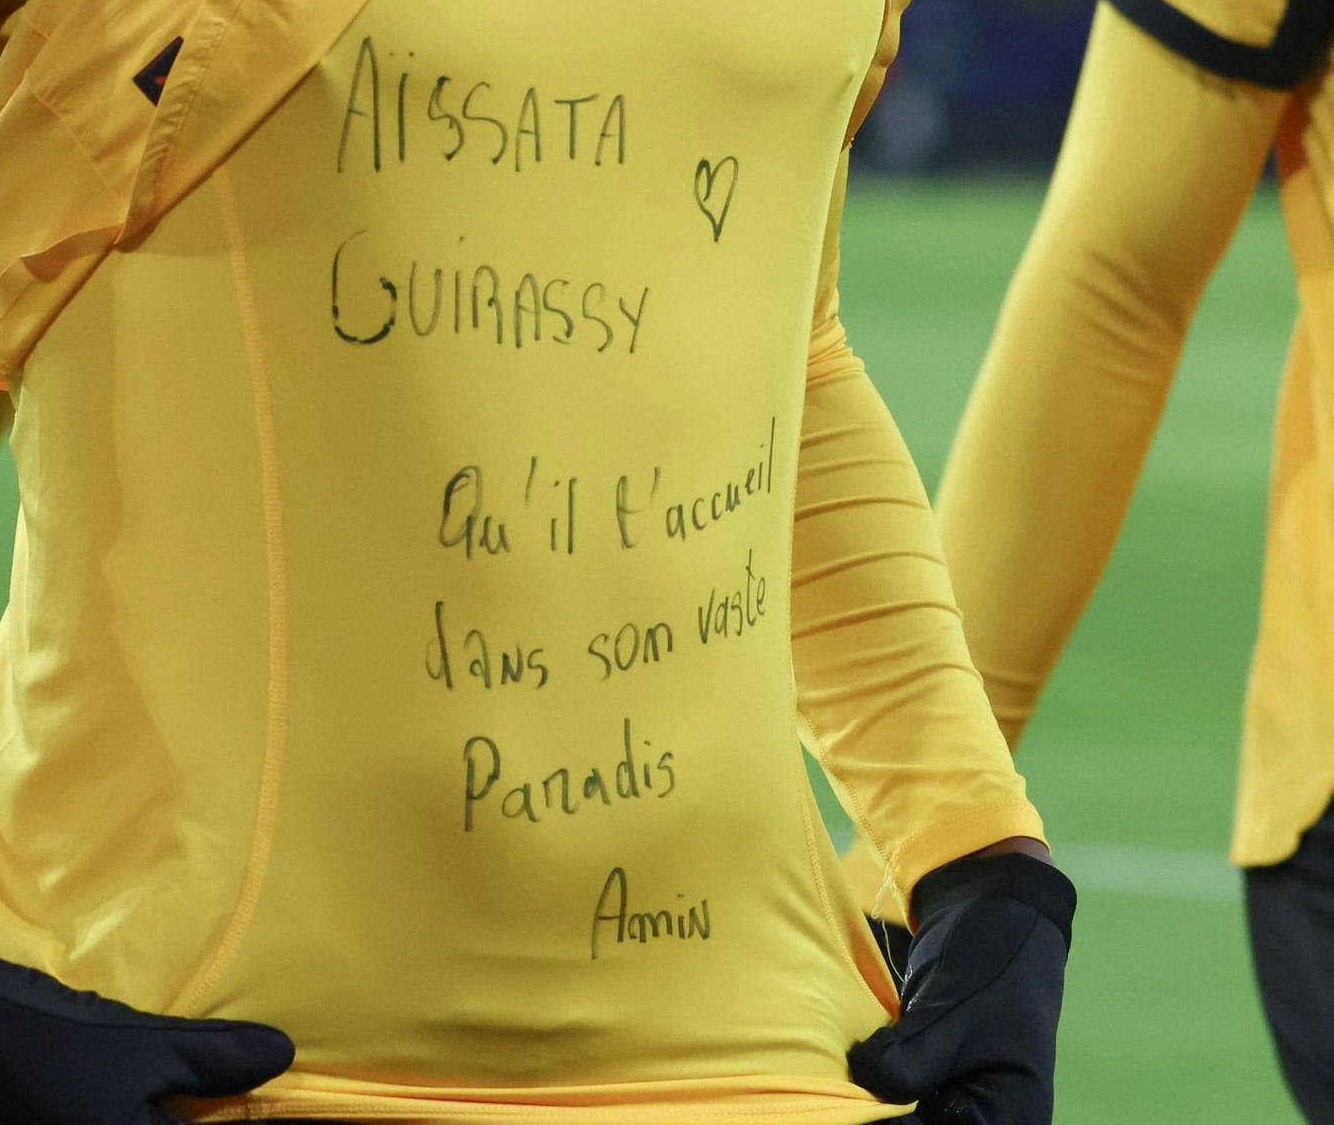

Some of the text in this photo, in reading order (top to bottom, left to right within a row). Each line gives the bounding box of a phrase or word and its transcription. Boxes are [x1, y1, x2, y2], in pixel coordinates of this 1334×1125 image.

[587, 621, 674, 681] son
[697, 547, 767, 646] vaste
[462, 717, 676, 833] Paradis
